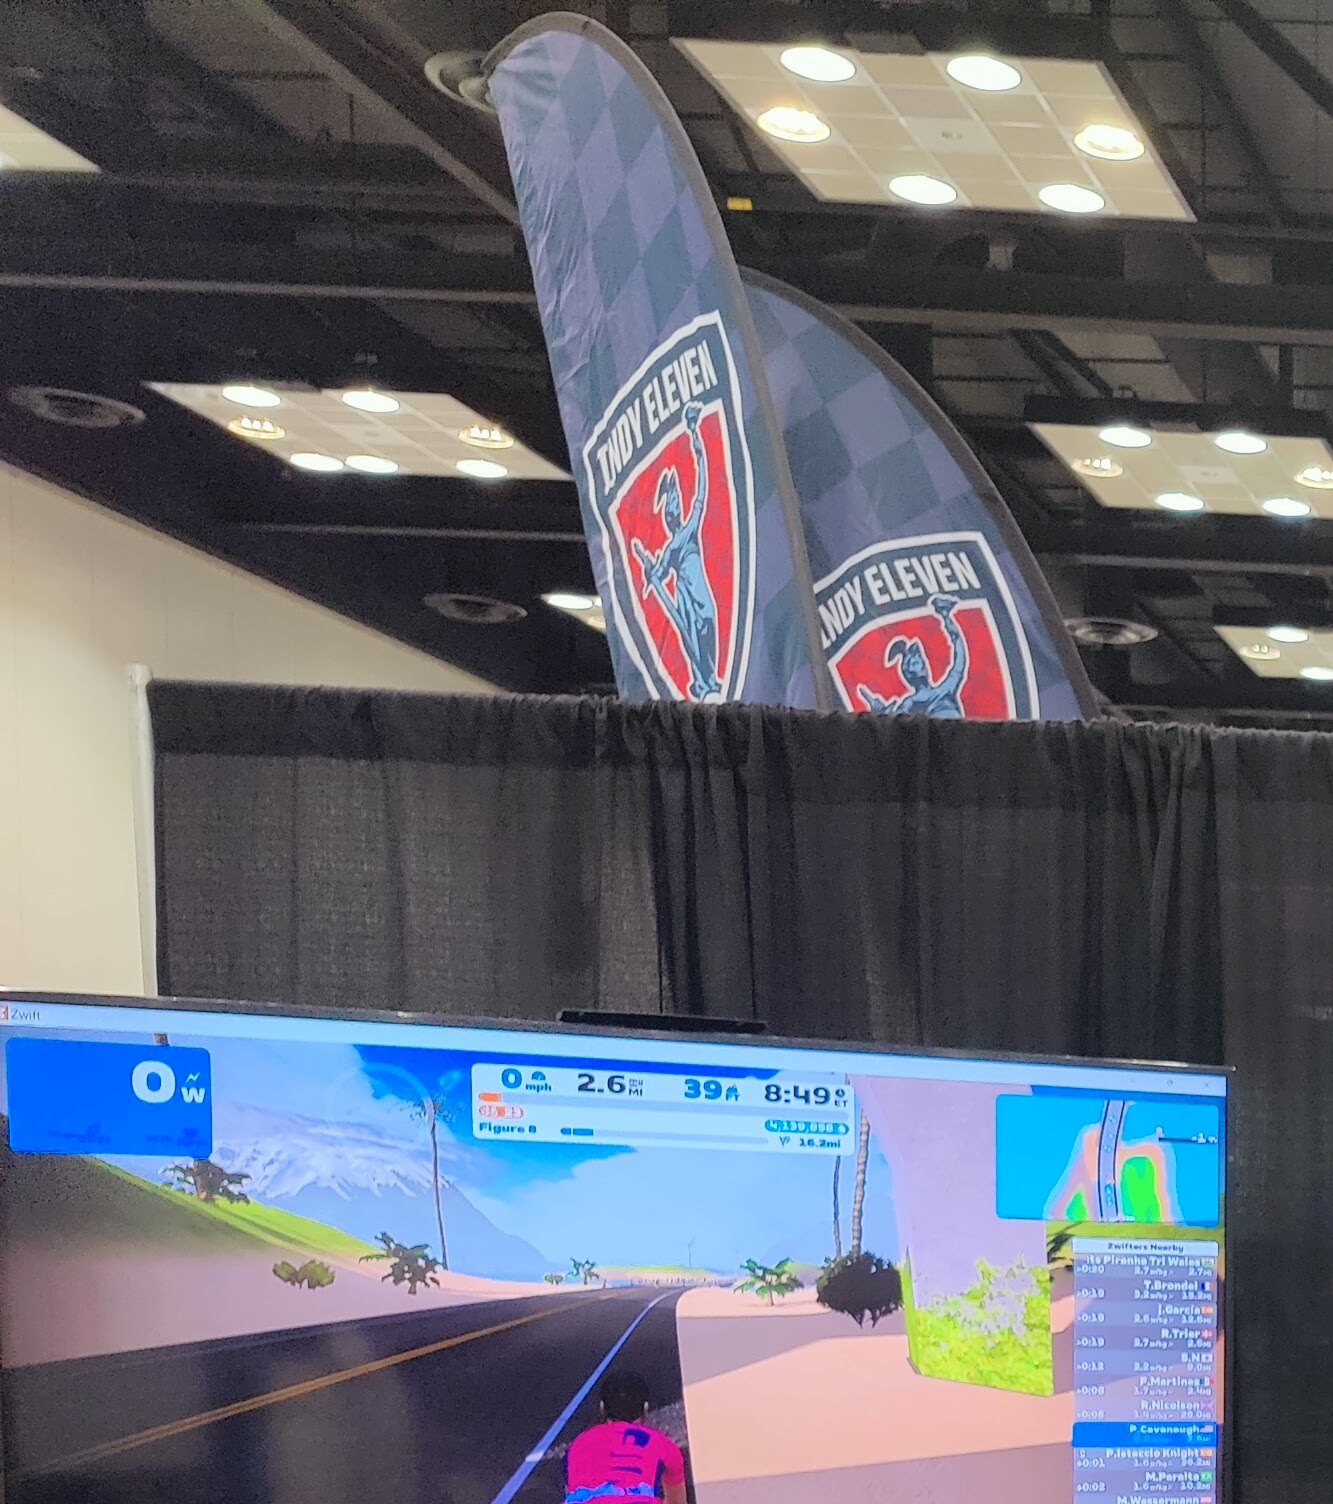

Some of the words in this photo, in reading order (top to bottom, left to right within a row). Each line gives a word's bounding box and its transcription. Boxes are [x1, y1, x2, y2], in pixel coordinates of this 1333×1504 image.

[597, 398, 643, 496] INDY
[643, 340, 718, 434] ELEVEN
[864, 552, 981, 605] ELEVEN
[11, 1007, 41, 1022] Zwift
[501, 1069, 522, 1089] 0
[526, 1081, 551, 1094] mph
[577, 1074, 625, 1095] 2.6
[684, 1078, 721, 1100] 39
[764, 1084, 831, 1106] 8:49
[479, 1122, 524, 1135] Figure
[1108, 1242, 1148, 1250] Zwifters
[1151, 1243, 1184, 1252] Nearby
